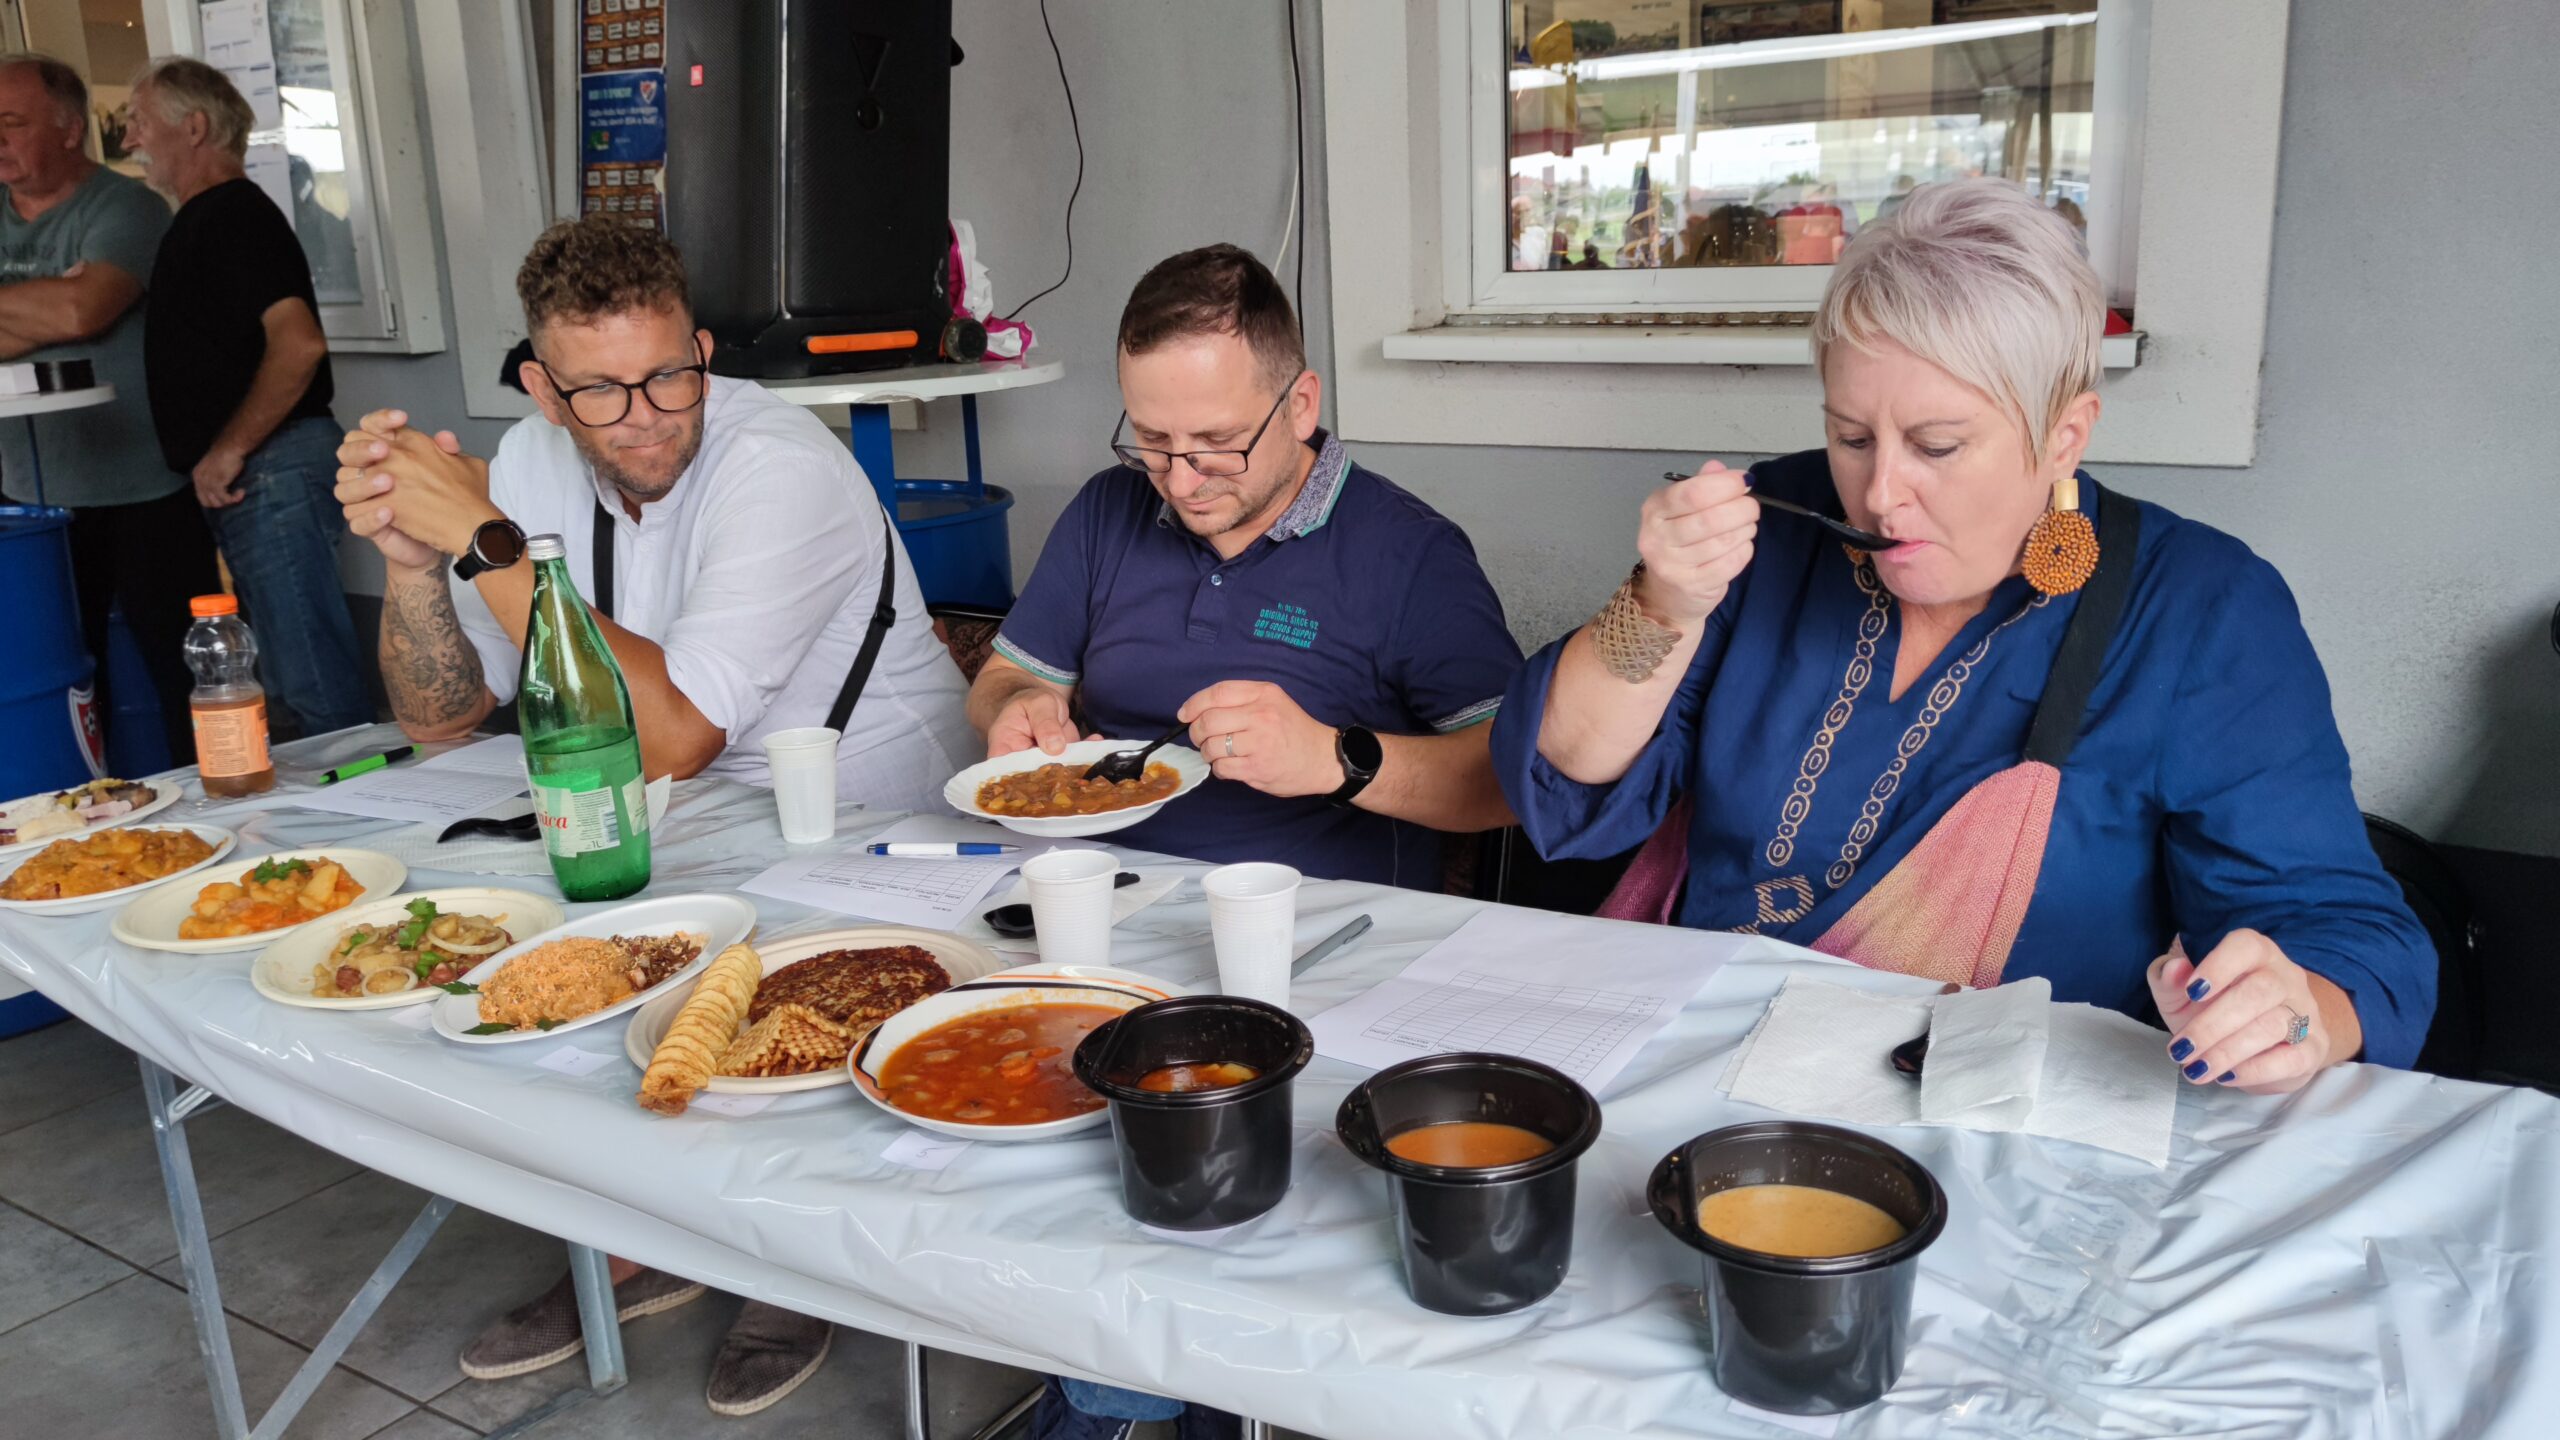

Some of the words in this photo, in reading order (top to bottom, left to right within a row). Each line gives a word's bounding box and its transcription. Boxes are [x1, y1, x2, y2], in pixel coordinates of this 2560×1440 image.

[1260, 609, 1288, 623] ORIGINAL
[1290, 615, 1309, 628] SINCE
[1254, 619, 1269, 629] DRY
[1270, 622, 1291, 634] GOODS
[1291, 628, 1317, 641] SUPPLY
